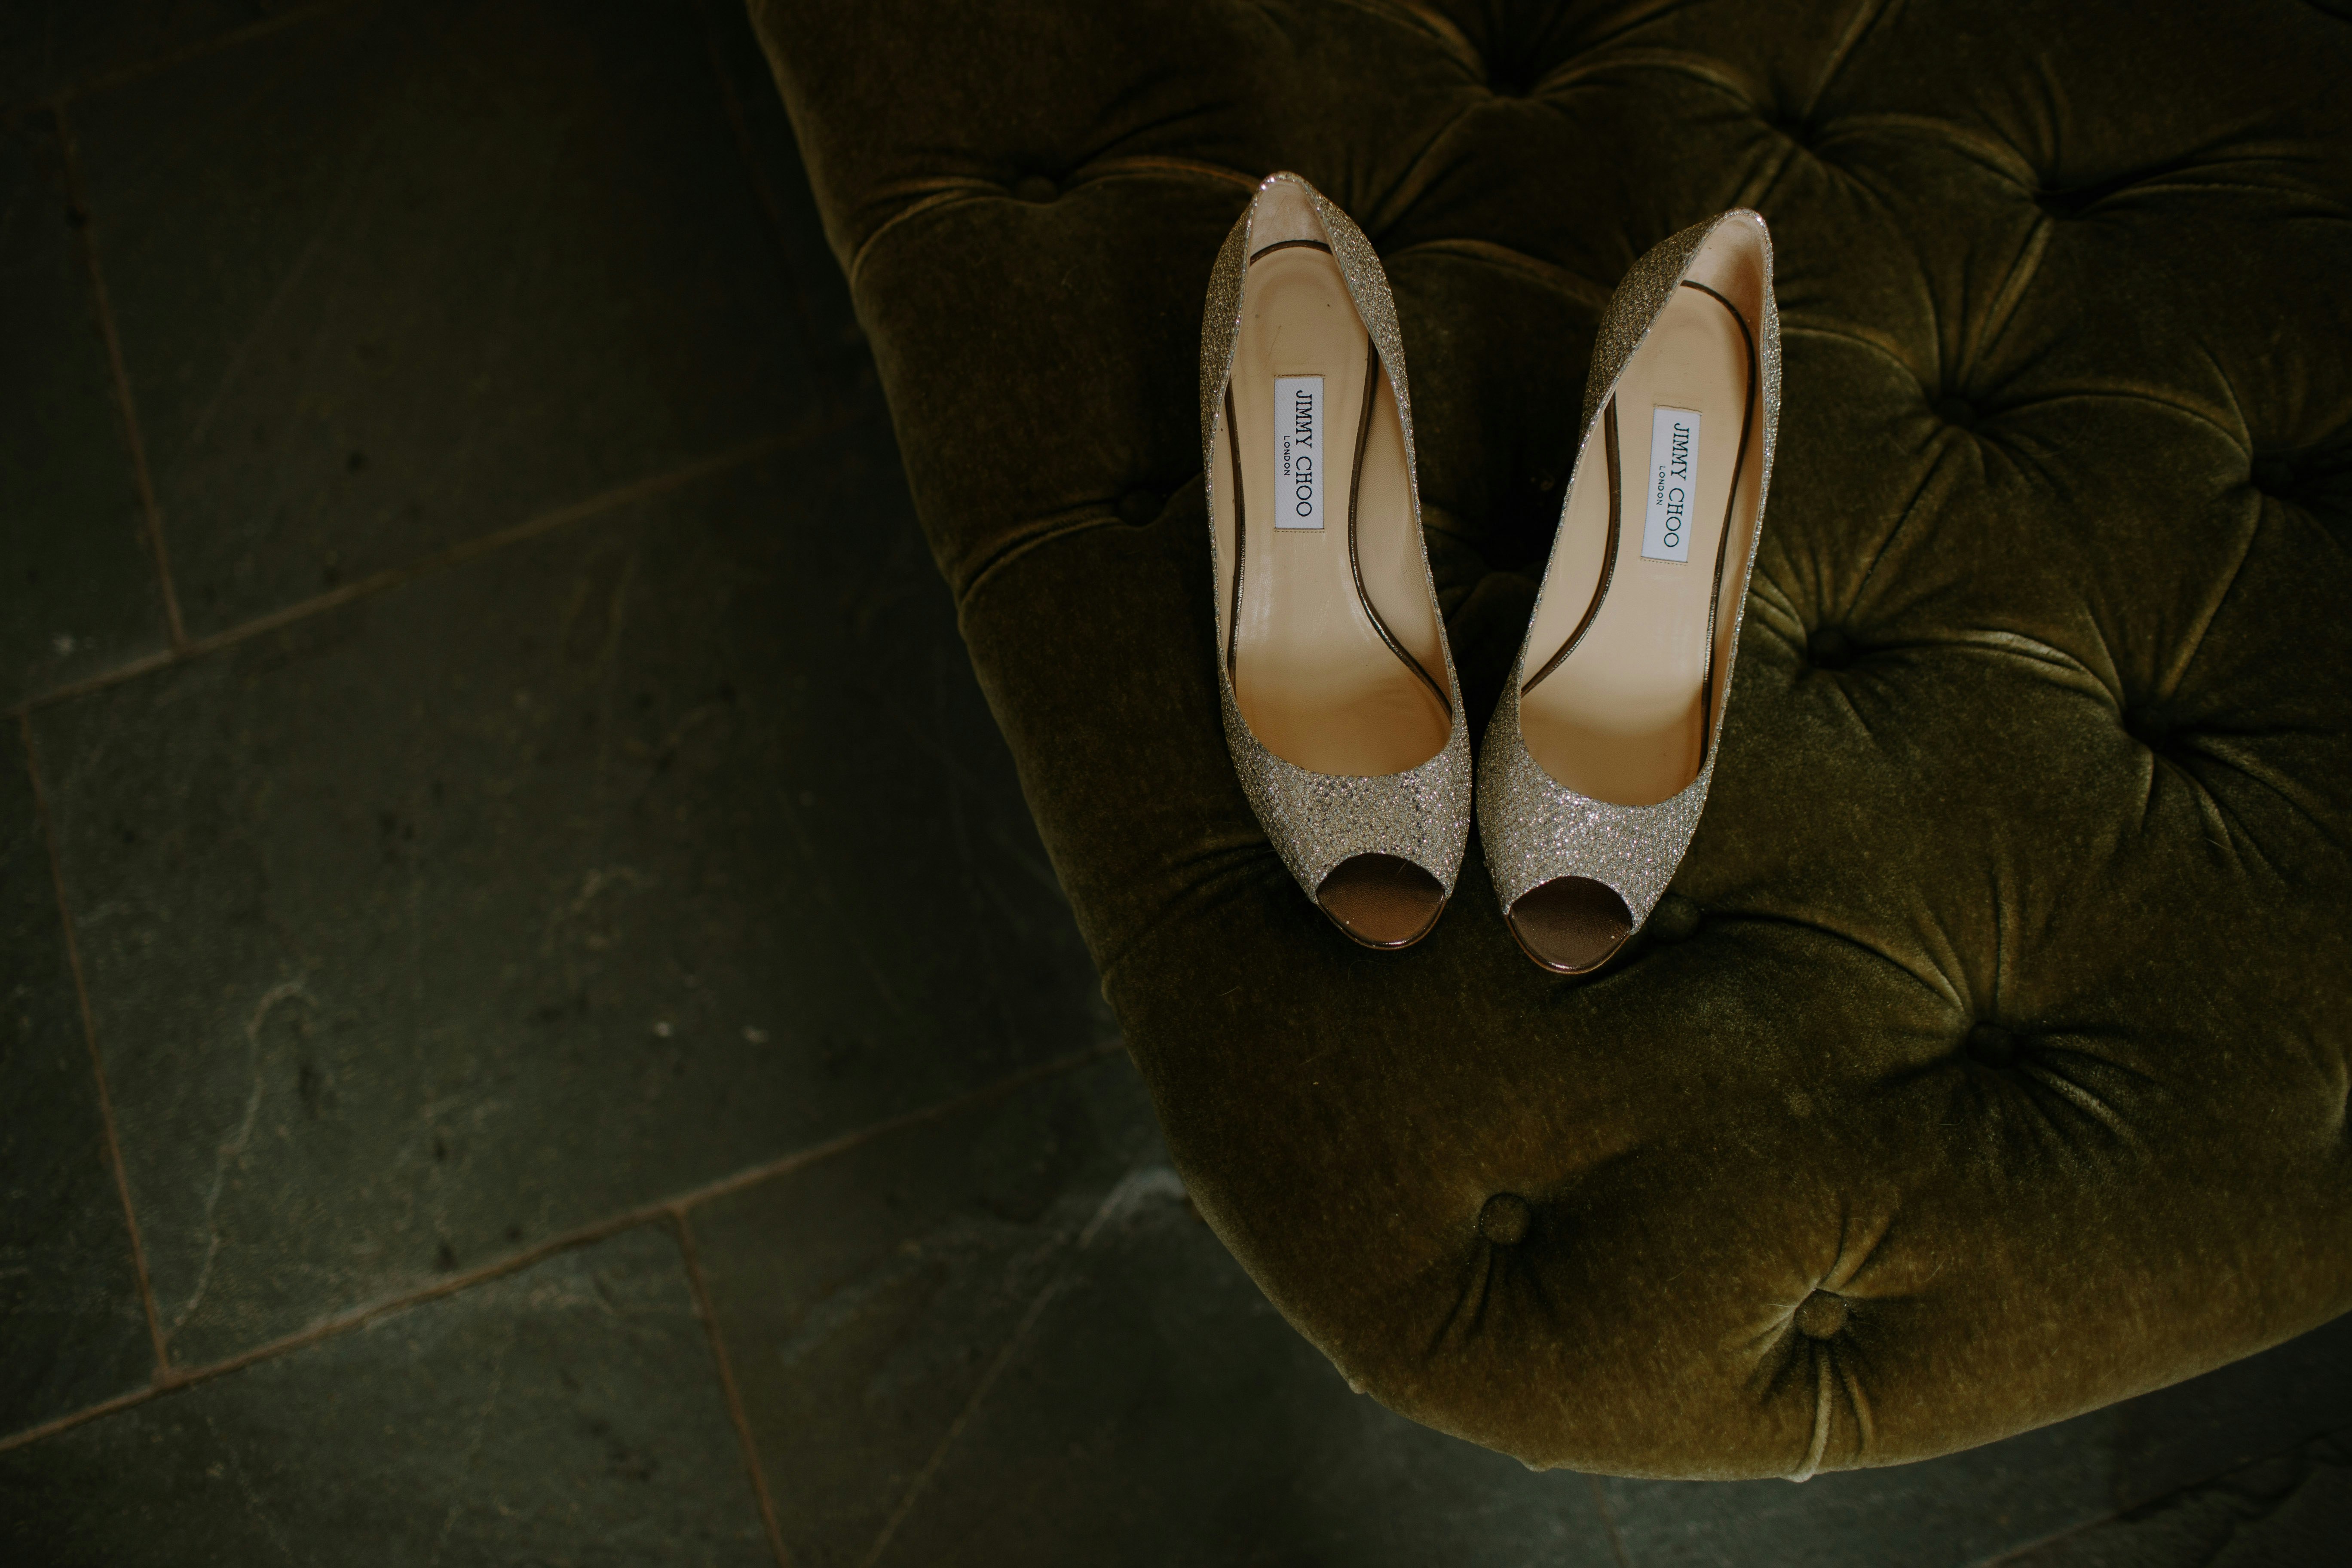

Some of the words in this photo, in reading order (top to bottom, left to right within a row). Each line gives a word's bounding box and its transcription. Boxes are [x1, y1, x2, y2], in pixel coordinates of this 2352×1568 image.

[1296, 390, 1312, 449] JIMMY
[1671, 423, 1689, 481] JIMMY
[1296, 456, 1312, 517] CHOO
[1656, 466, 1666, 505] LONDON
[1664, 488, 1684, 547] CHOO
